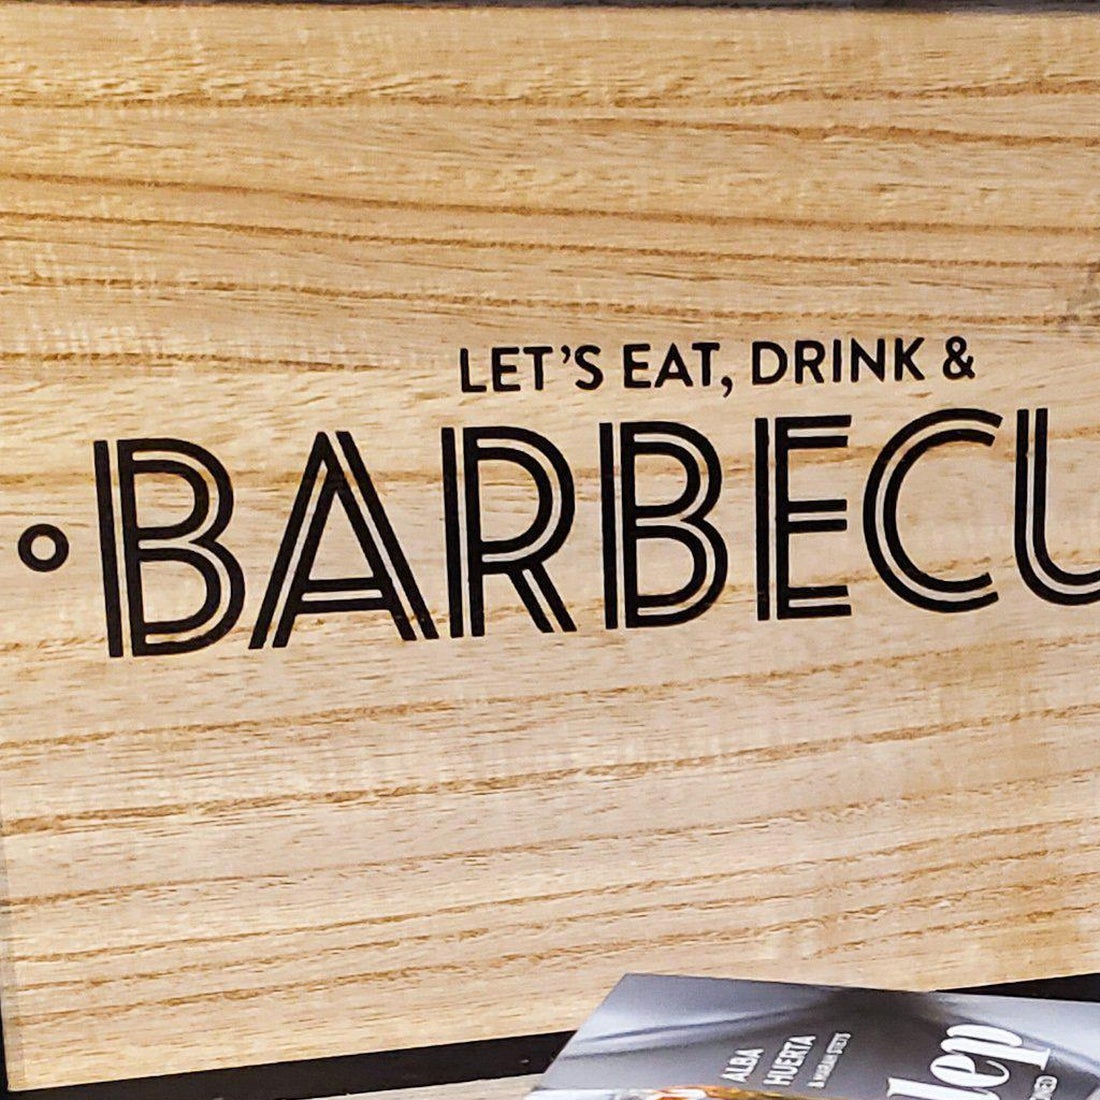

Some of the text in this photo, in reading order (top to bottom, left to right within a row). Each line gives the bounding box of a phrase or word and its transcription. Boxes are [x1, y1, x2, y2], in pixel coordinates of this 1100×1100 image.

[461, 336, 976, 398] LET'S EAT, DRINK &
[721, 1048, 765, 1084] ALBA
[763, 1035, 817, 1087] HUERTA
